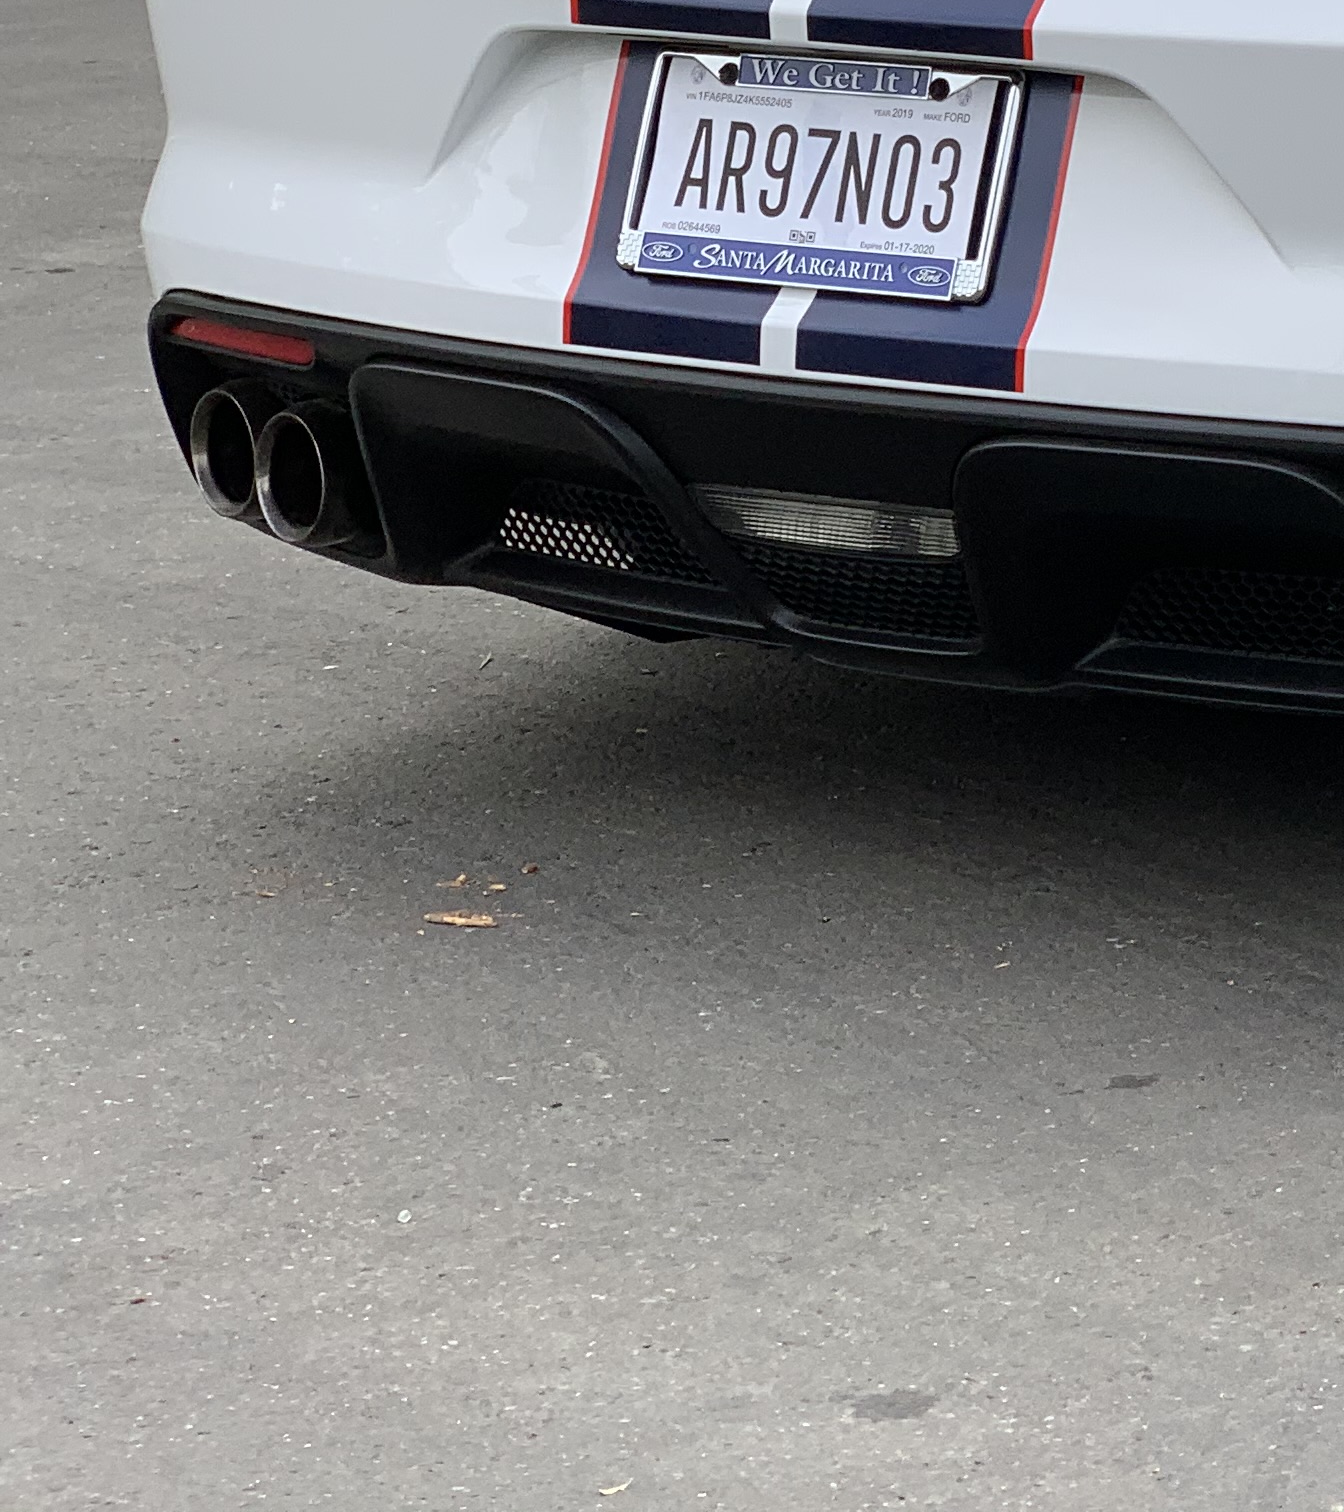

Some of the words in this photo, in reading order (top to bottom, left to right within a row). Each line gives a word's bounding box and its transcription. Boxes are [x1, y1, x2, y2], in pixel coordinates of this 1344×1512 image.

[751, 58, 800, 86] We
[808, 62, 864, 91] Get
[871, 67, 900, 93] It
[873, 109, 891, 118] YEAR
[892, 108, 914, 120] 2019
[923, 113, 943, 122] MAKE
[943, 111, 971, 124] FORD
[673, 118, 962, 234] AR97N03
[677, 220, 721, 235] 02644569
[649, 243, 680, 259] Ford
[883, 240, 935, 256] 01-17-2020
[693, 243, 766, 271] SANTA
[760, 248, 894, 283] MARGARITA
[915, 267, 943, 284] Ford
